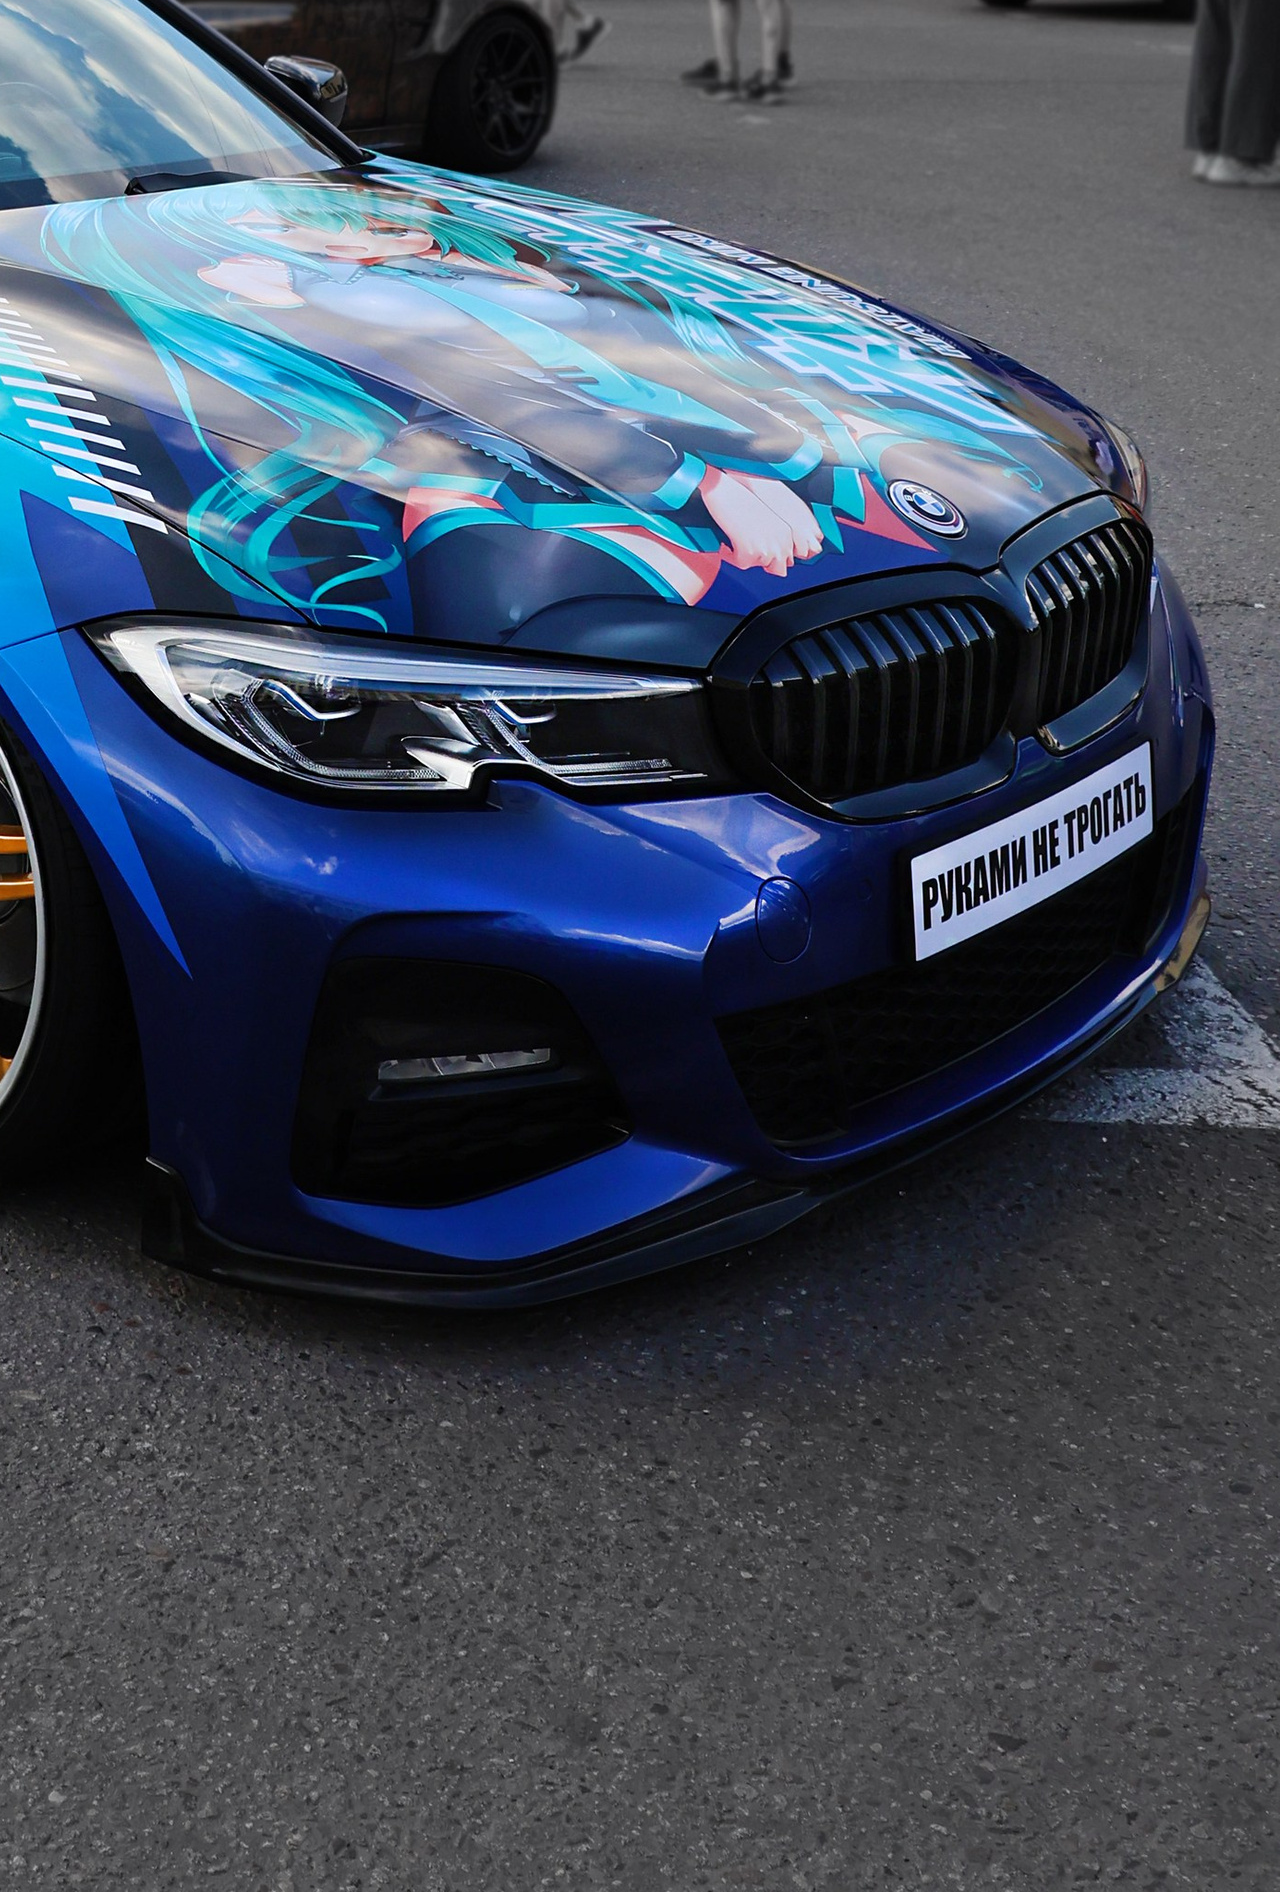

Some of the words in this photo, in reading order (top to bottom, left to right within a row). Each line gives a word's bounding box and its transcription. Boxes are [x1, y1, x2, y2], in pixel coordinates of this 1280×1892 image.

[658, 229, 778, 265] MIKU
[765, 266, 972, 360] HATSUNE
[922, 835, 1028, 931] РУКАМИ
[1032, 819, 1061, 877] НЕ
[1063, 772, 1146, 859] ТРОГАТЬ
